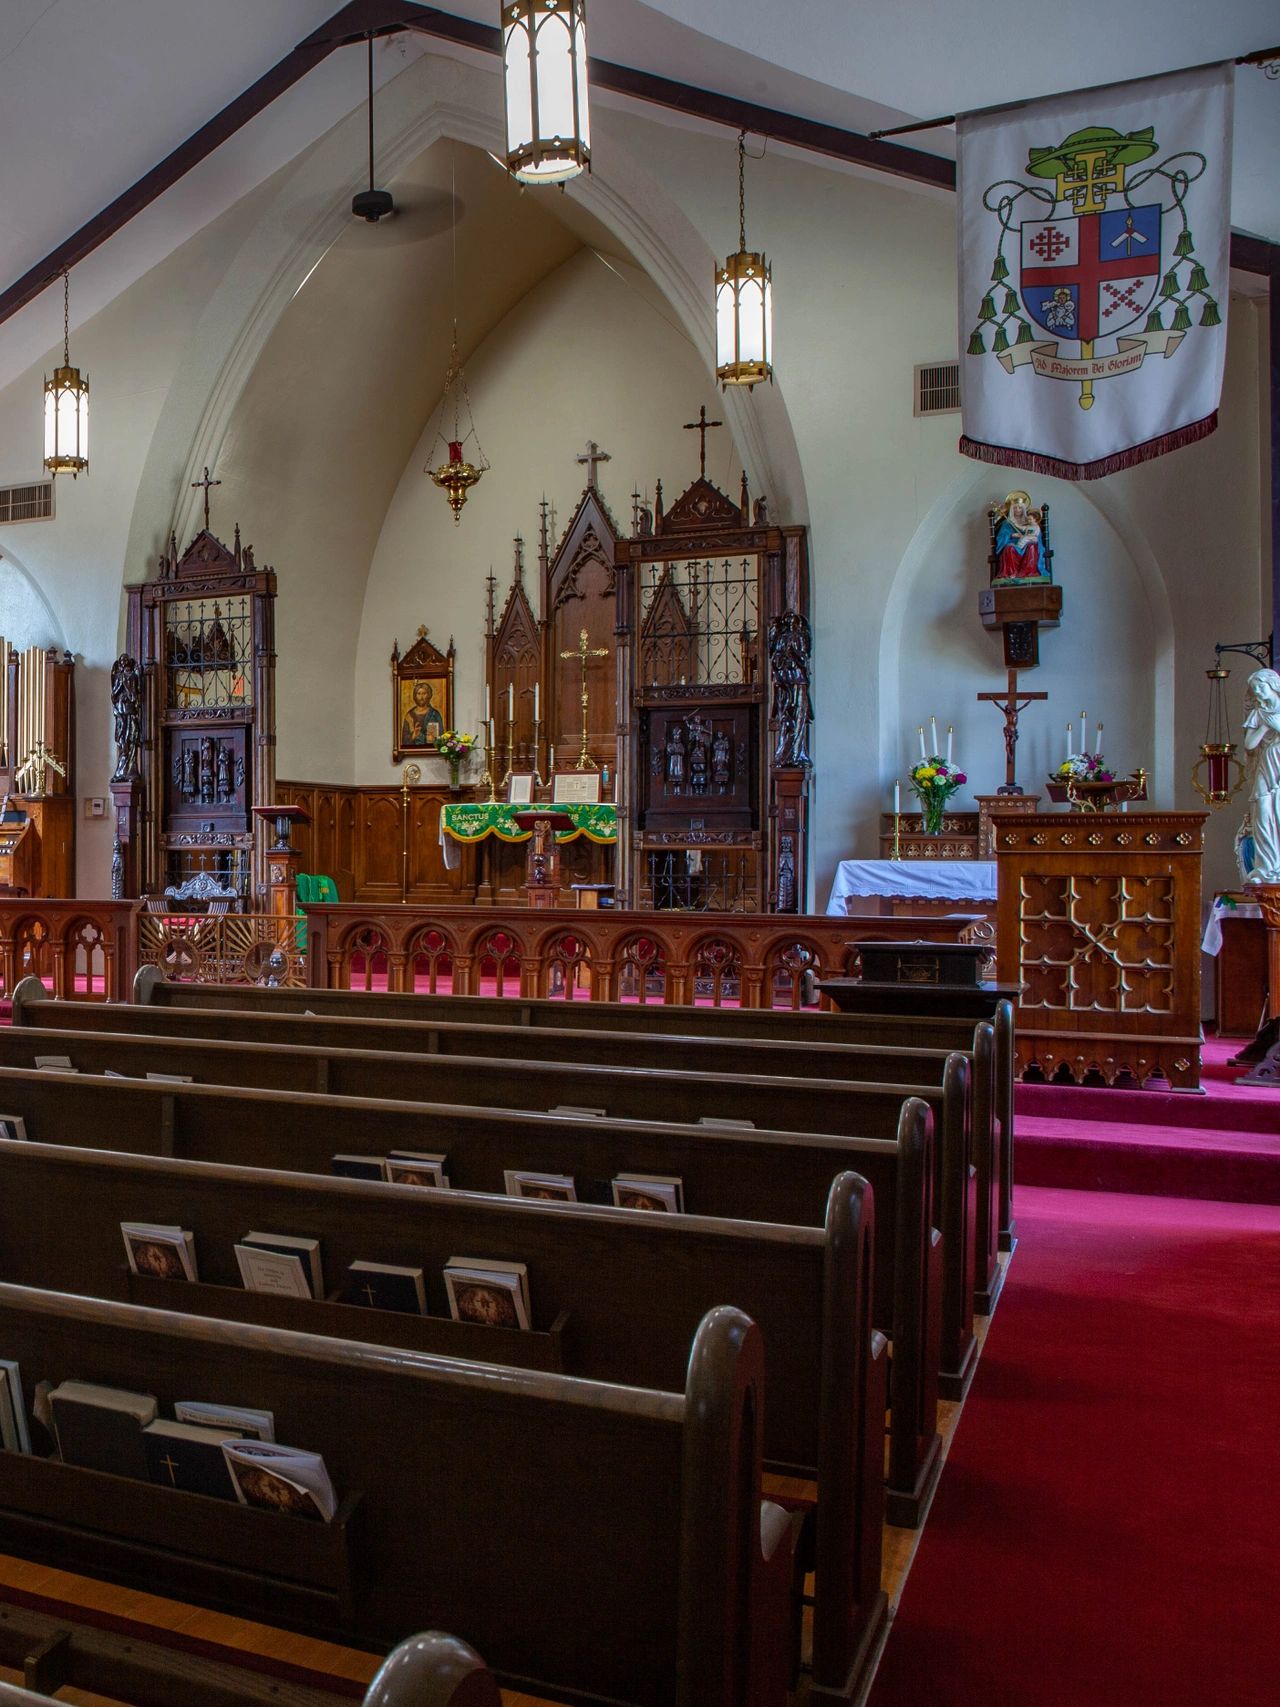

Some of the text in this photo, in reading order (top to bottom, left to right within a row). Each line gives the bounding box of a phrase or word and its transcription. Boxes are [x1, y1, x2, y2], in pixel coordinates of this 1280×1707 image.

[1036, 354, 1142, 376] Ad Majorem Dei Gloriam
[451, 813, 489, 821] SANCTUS
